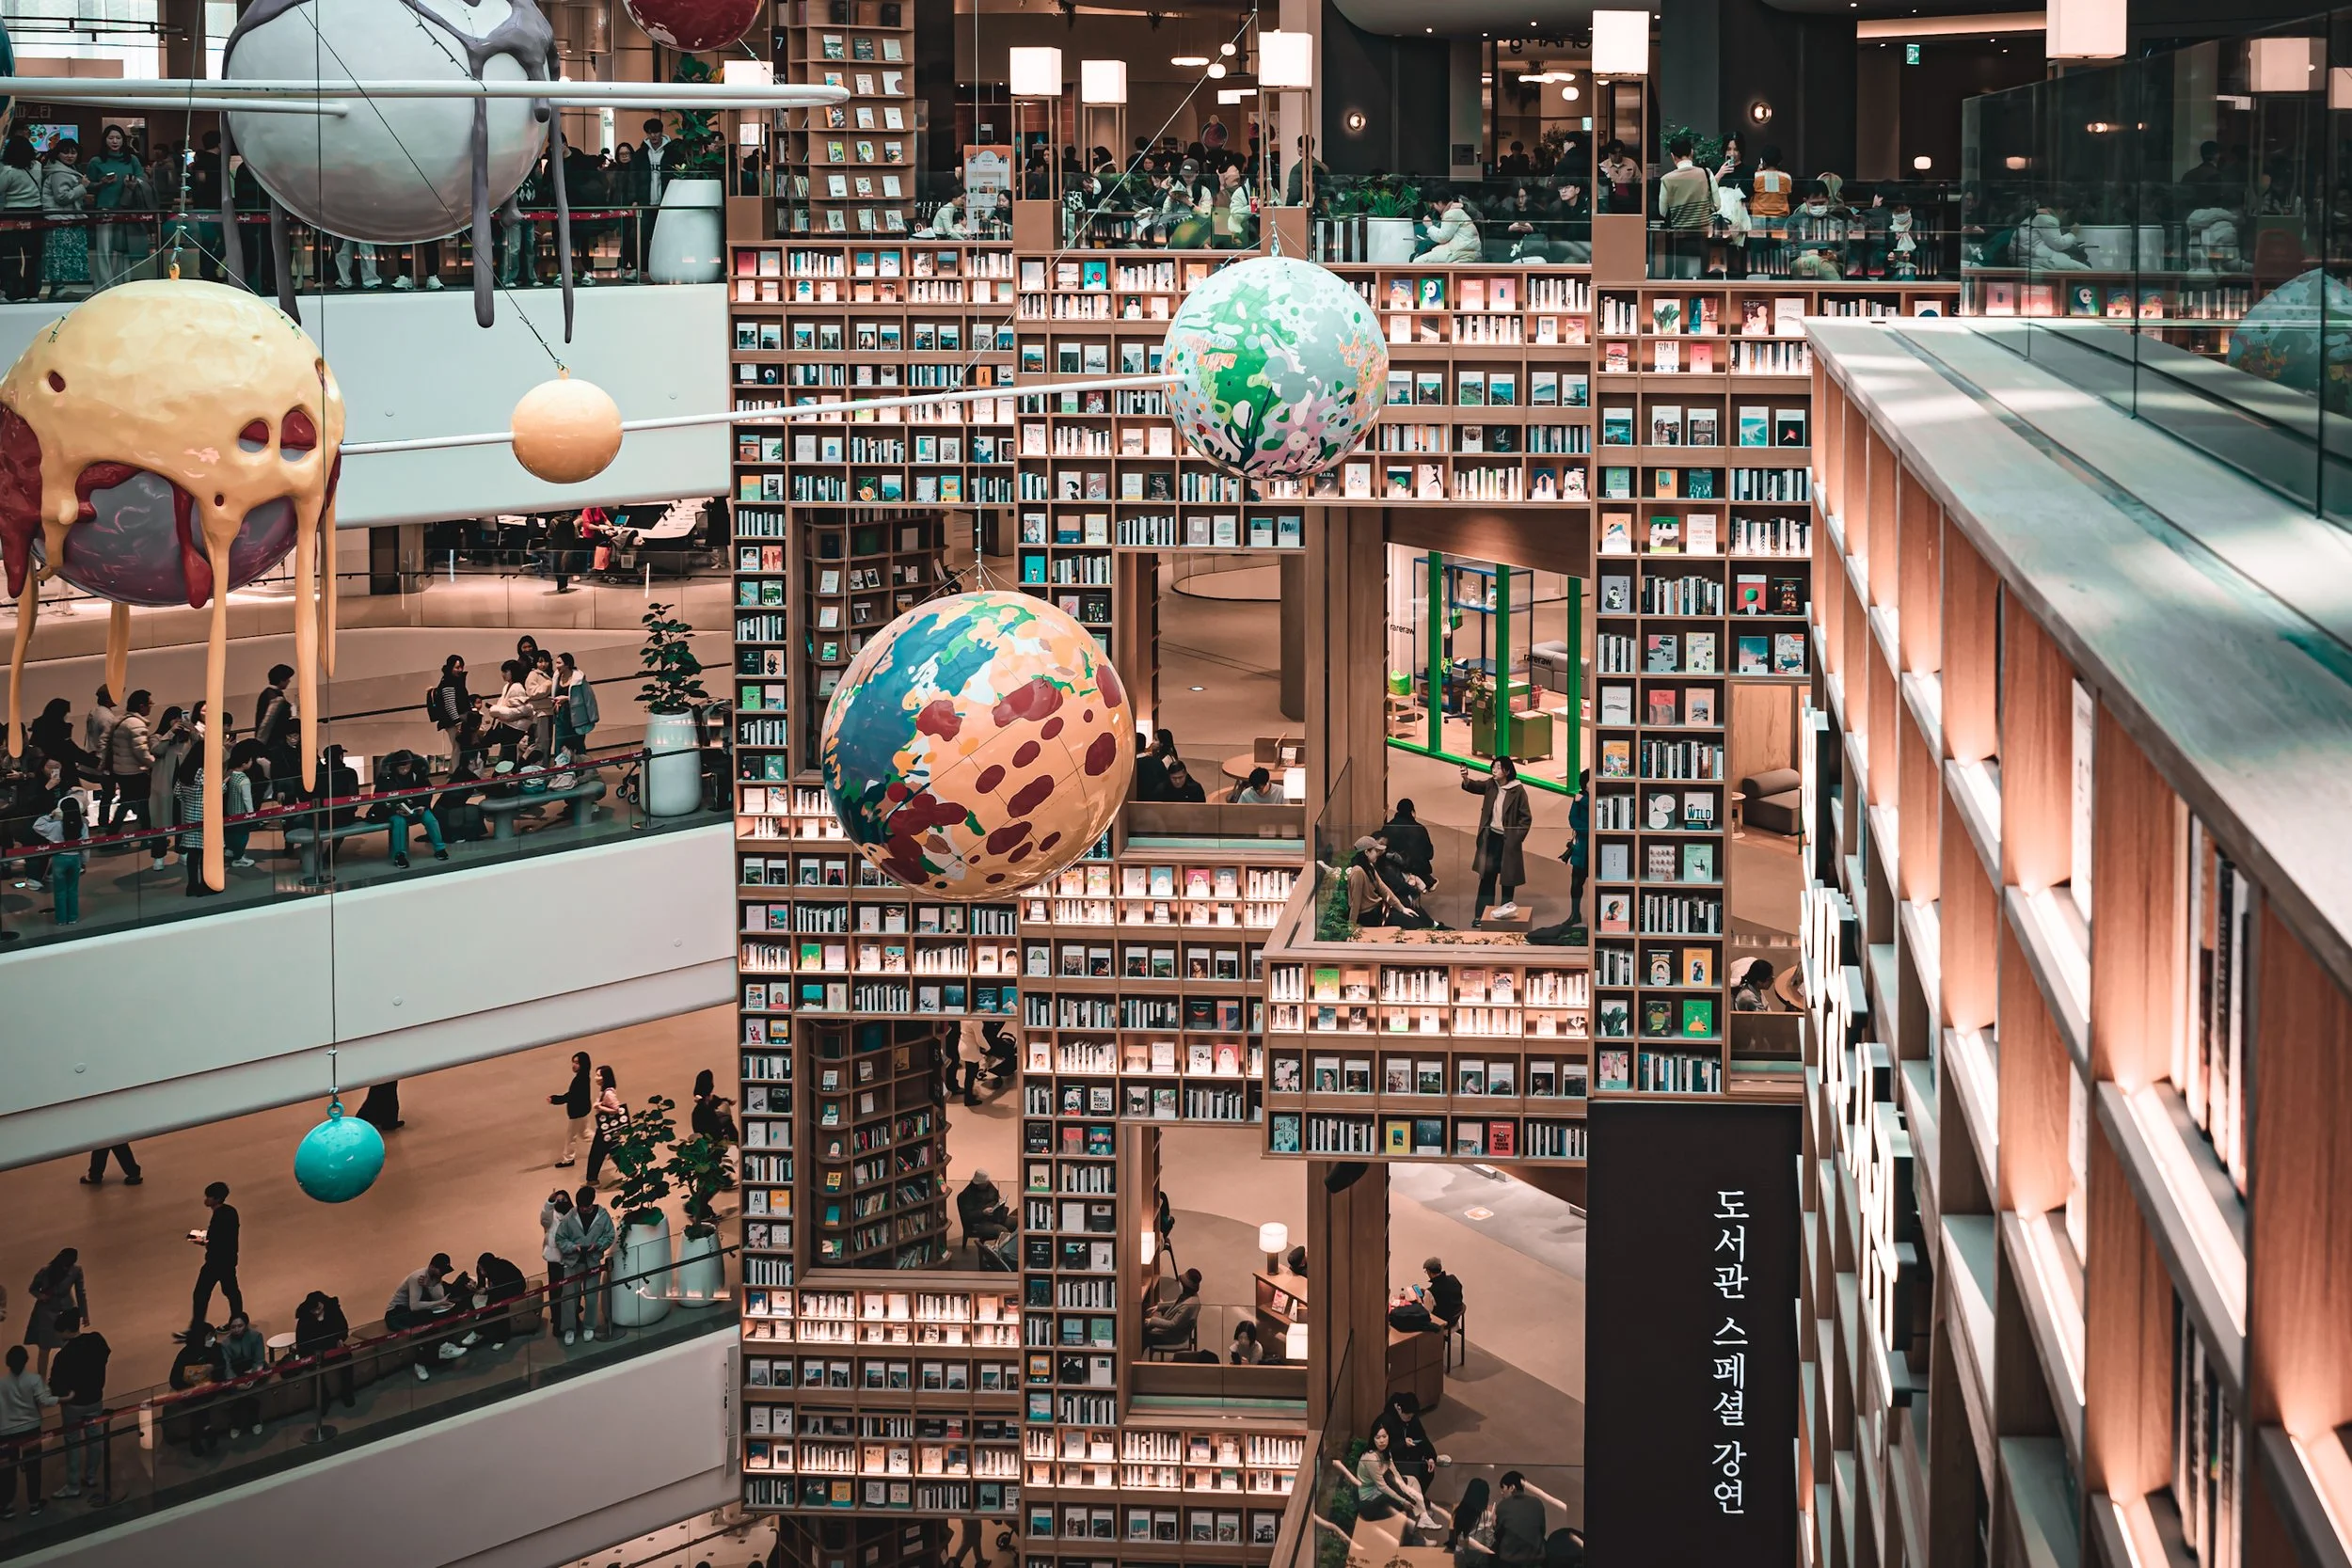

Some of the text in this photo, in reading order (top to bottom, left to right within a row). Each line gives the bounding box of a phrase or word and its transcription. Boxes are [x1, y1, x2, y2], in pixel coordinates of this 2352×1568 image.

[774, 36, 784, 50] 7
[1523, 654, 1552, 666] rareraw
[1687, 807, 1711, 819] WILD
[754, 1193, 762, 1203] AI
[1711, 1190, 1750, 1514] 도서관 스페셜 강연
